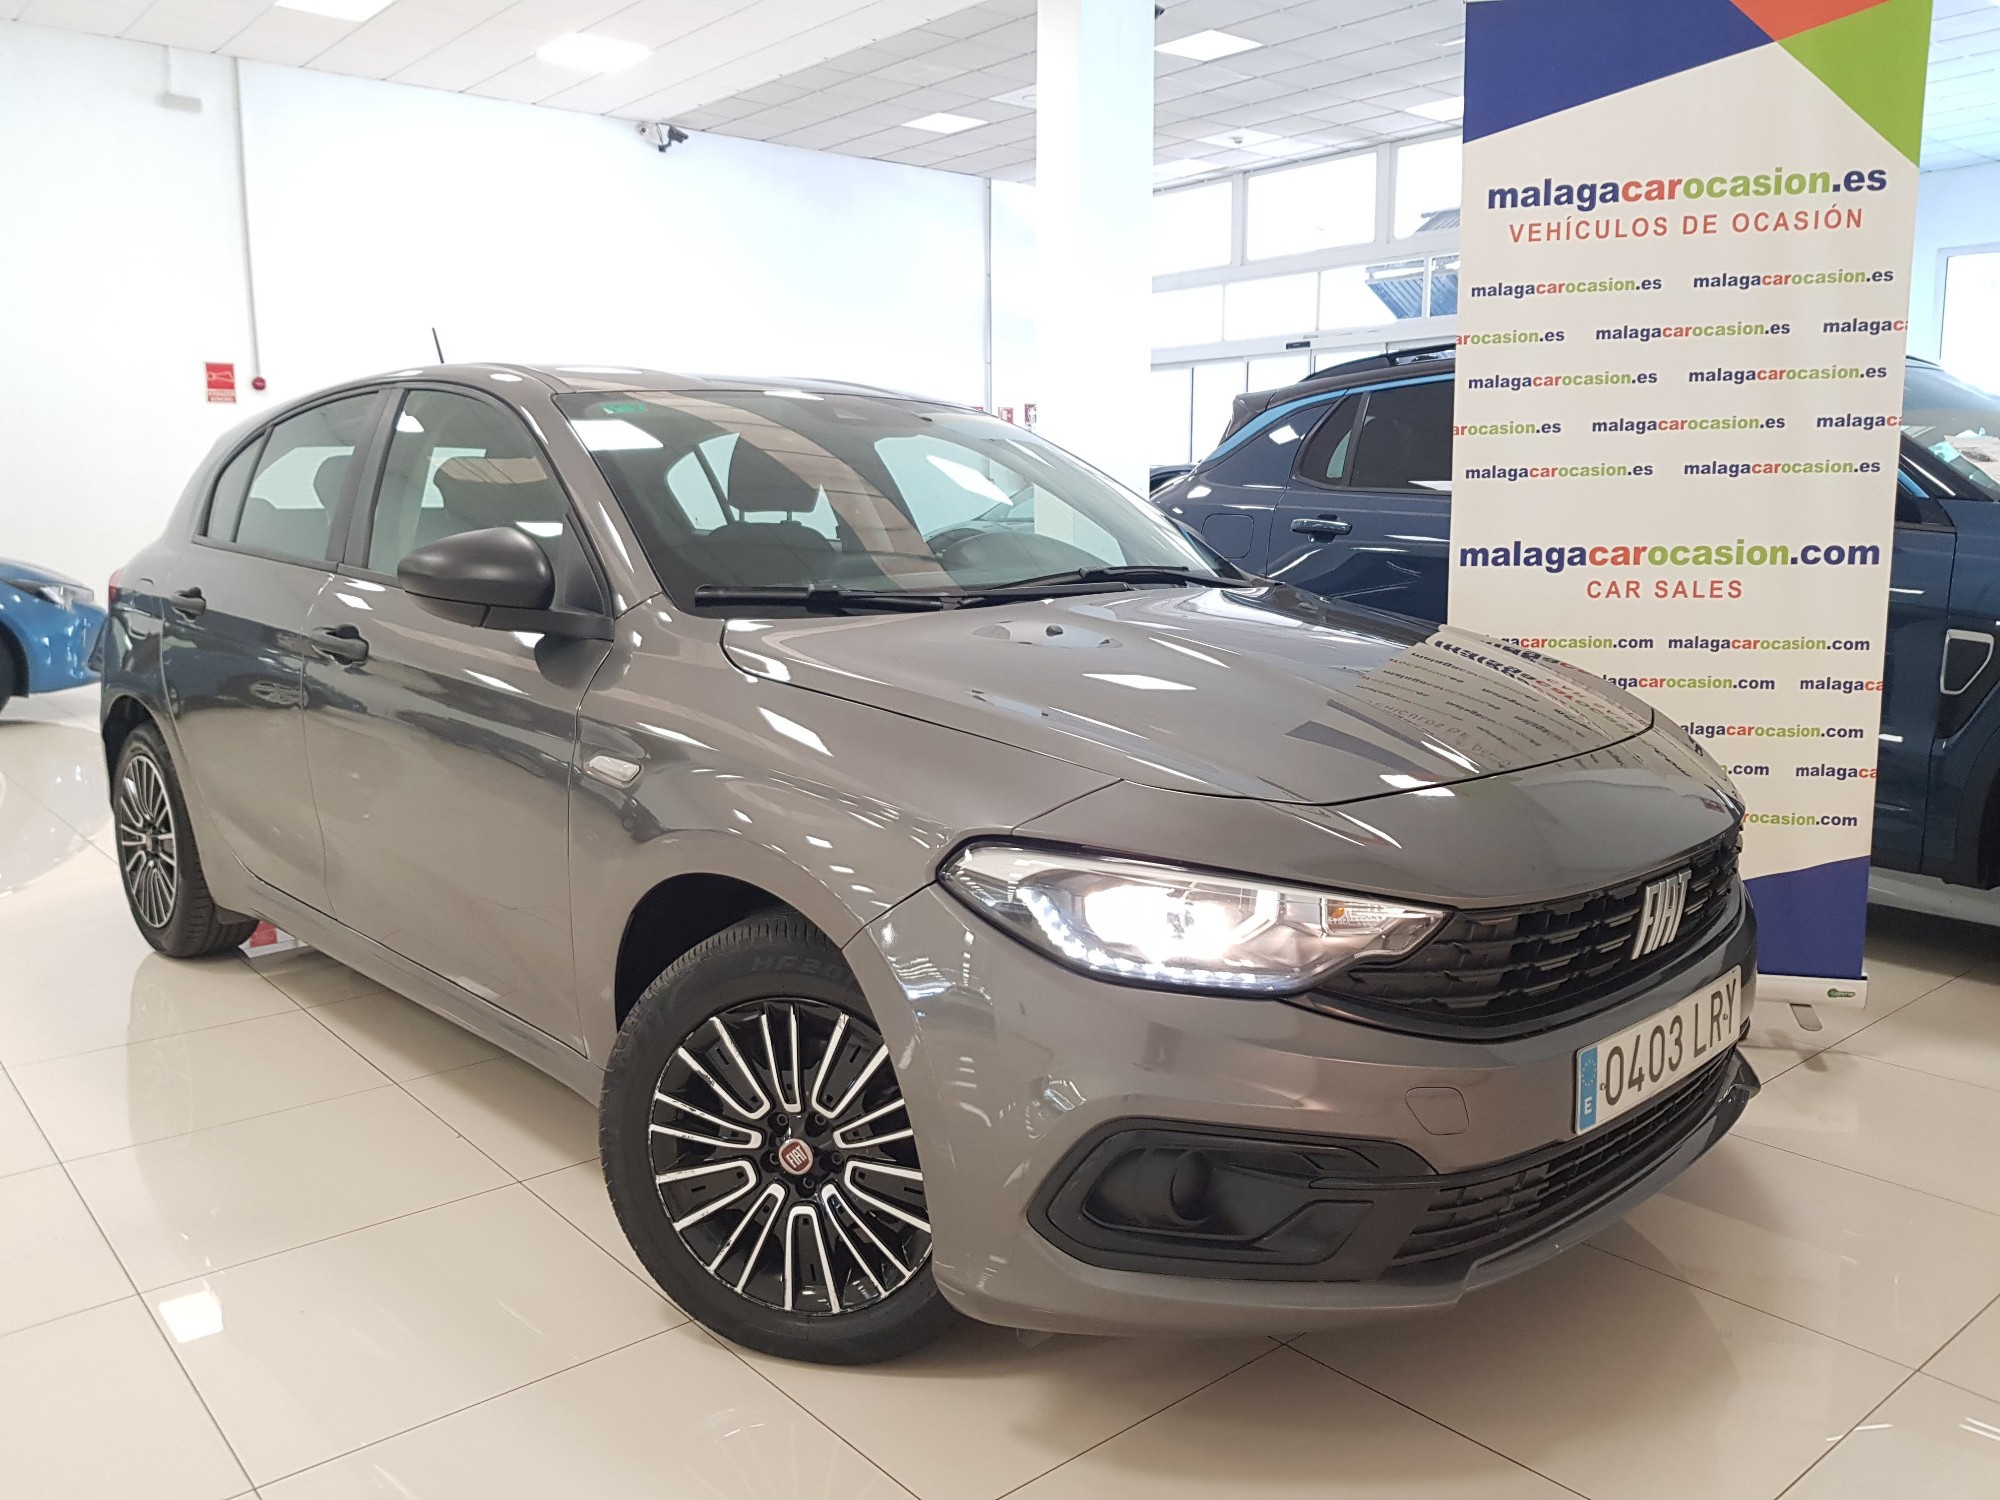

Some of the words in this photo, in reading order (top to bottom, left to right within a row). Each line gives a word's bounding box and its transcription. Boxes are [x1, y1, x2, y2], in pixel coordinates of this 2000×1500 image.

[1488, 167, 1887, 211] malagacarocasion.es
[1509, 211, 1667, 243] VEHÍCULOS
[1683, 214, 1717, 235] DE
[1732, 203, 1862, 232] OCASIÓN
[1472, 278, 1662, 299] malagacarocasion.es
[1694, 269, 1893, 290] malagacarocasion.es
[1596, 321, 1790, 342] malagacarocasion.es
[1823, 317, 1908, 336] malagac
[1469, 371, 1657, 391] malagacarocasion.es
[1689, 365, 1887, 384] malagacarocasion.es
[1592, 416, 1785, 434] malagacarocasion.es
[1466, 463, 1654, 481] malagacarocasion.es
[1684, 459, 1880, 478] malagacarocasion.es
[1460, 539, 1880, 573] malagacarocasion.com
[1587, 581, 1641, 599] CAR
[1655, 580, 1742, 599] SALES
[1668, 636, 1870, 652] malagacarocasion.com
[1630, 869, 1692, 960] FIAT
[1605, 1015, 1683, 1106] 0403
[1693, 978, 1737, 1059] LRY
[1584, 1097, 1593, 1115] E
[786, 1145, 808, 1168] FIAT
